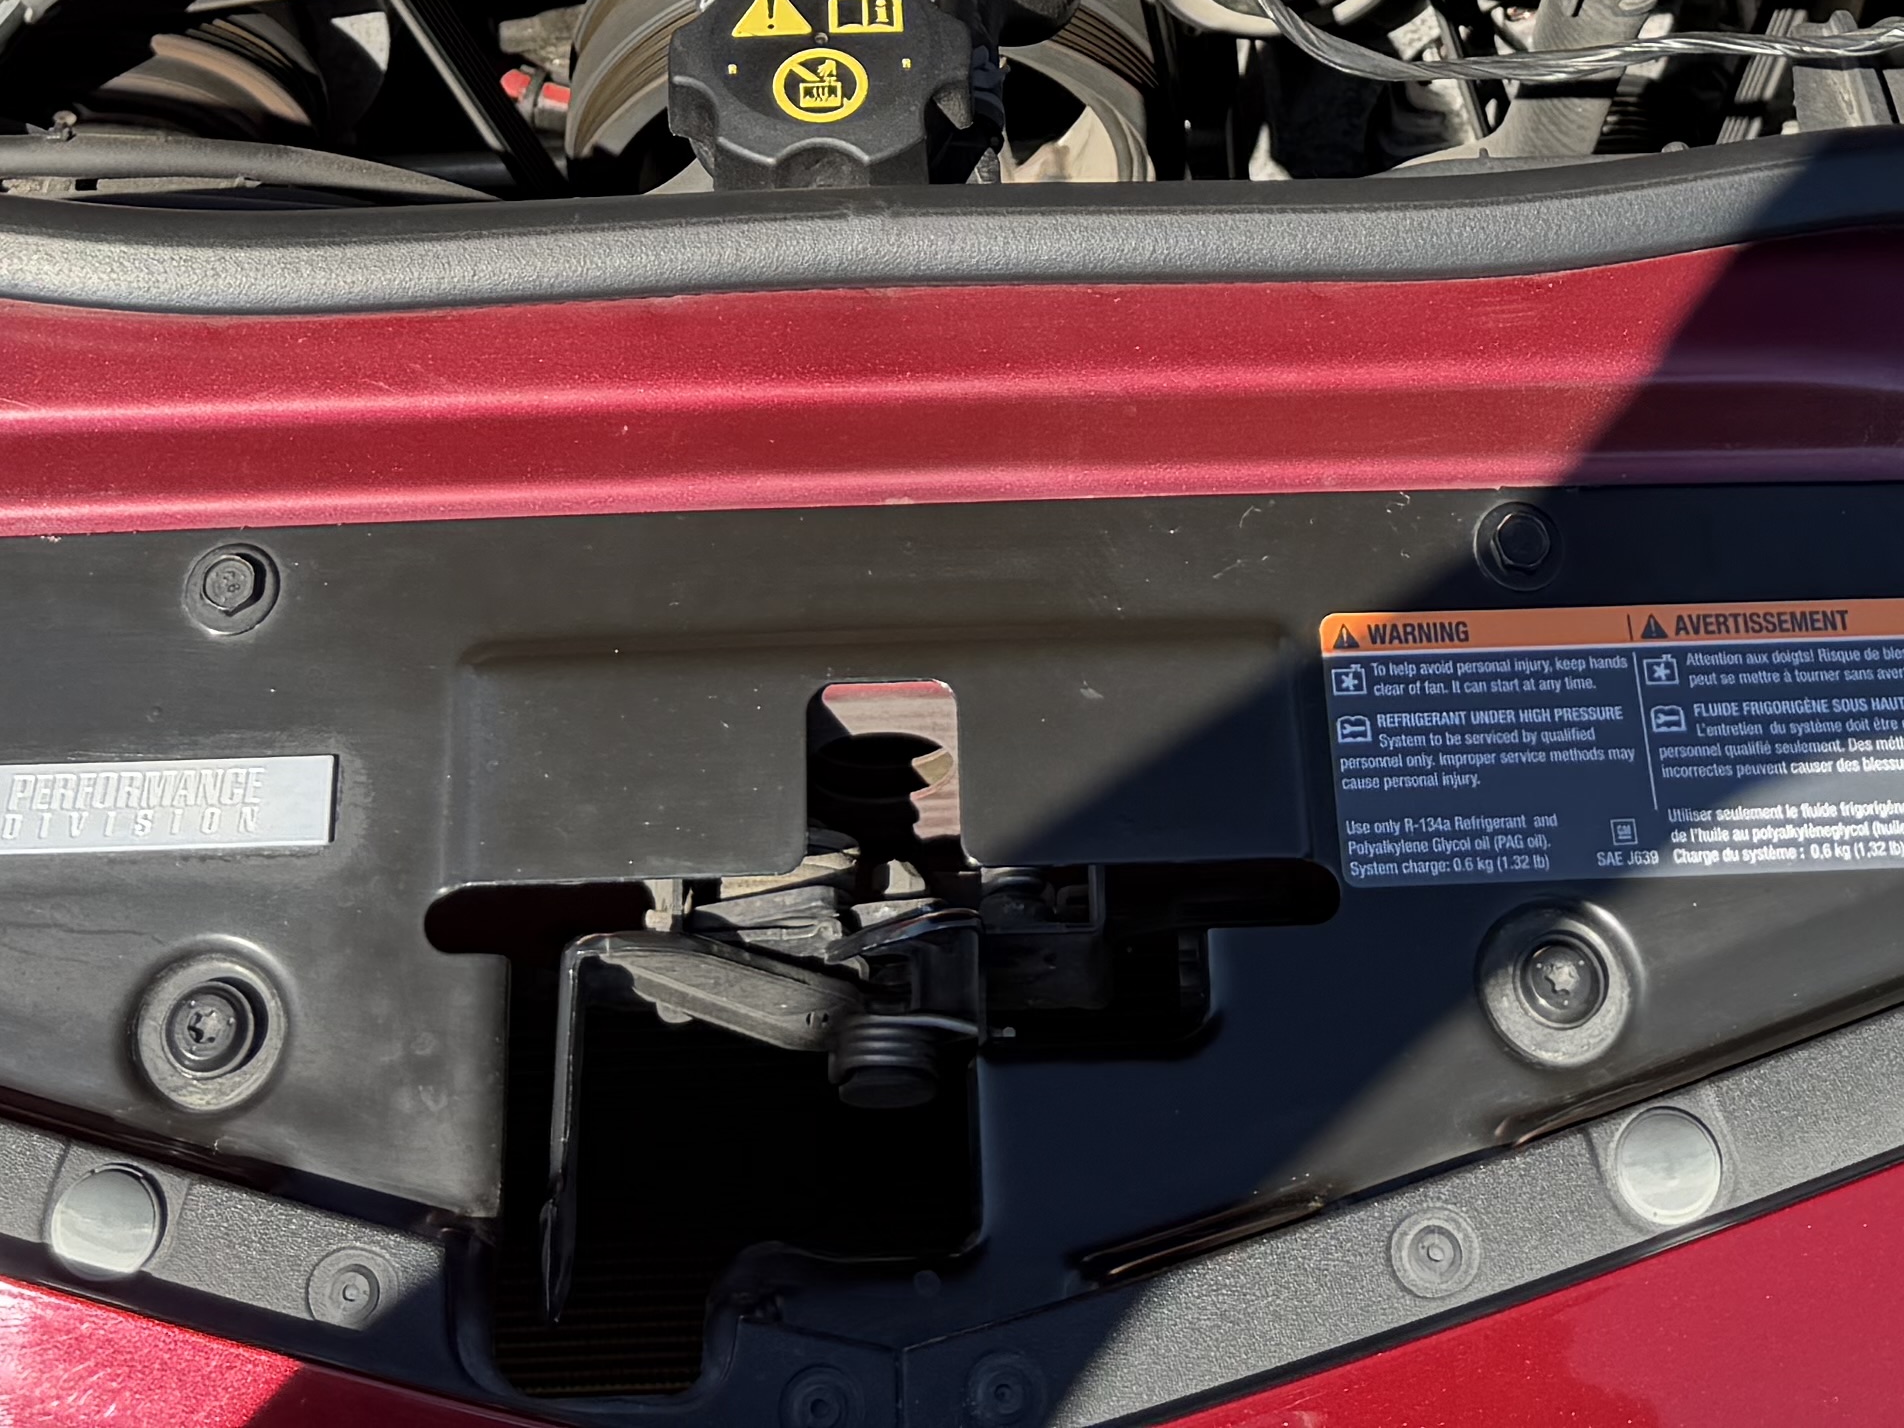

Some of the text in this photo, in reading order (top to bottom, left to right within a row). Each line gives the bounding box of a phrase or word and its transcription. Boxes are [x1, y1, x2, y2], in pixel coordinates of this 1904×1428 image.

[1366, 621, 1470, 645] WARNING
[1674, 609, 1848, 636] AVERTISSEMENT
[1372, 655, 1627, 677] To help avoid personal injury, keep hands
[1686, 651, 1743, 665] Attention
[1746, 653, 1769, 664] aux
[1772, 649, 1814, 665] doigts!
[1818, 648, 1860, 663] Risque
[1864, 647, 1879, 660] de
[1374, 676, 1596, 696] clear of fan. It can start at any time.
[1689, 672, 1717, 688] peut
[1720, 674, 1735, 684] se
[1739, 670, 1780, 684] mettre
[1783, 668, 1792, 682] à
[1794, 669, 1840, 682] tourner
[1843, 669, 1874, 680] sans
[1377, 706, 1623, 727] REFRIGERANT UNDER HIGH PRESSURE
[1693, 702, 1739, 716] FLUIDE
[1742, 697, 1830, 715] FRIGORIGÈNE
[1832, 698, 1867, 712] SOUS
[1696, 721, 1762, 736] L'entretien
[1770, 721, 1786, 734] du
[1789, 718, 1841, 735] système
[1845, 718, 1870, 732] doit
[1873, 717, 1898, 731] être
[1379, 727, 1595, 749] System to be serviced by qualified
[1340, 747, 1634, 771] personnel only. Improper service methods may
[1659, 743, 1721, 760] personnel
[1725, 740, 1771, 758] qualifié
[1775, 739, 1845, 754] seulement.
[1848, 738, 1872, 752] Des
[1661, 763, 1732, 778] incorrectes
[1736, 761, 1788, 778] peuvent
[1790, 761, 1833, 774] causer
[1837, 758, 1859, 772] des
[7, 768, 266, 812] PERFORMANCE
[1342, 771, 1480, 790] cause personal injury.
[1668, 808, 1712, 823] Utiliser
[1716, 804, 1784, 821] seulement
[1785, 804, 1797, 818] le
[1801, 802, 1837, 819] fluide
[1346, 820, 1370, 835] Use
[1374, 819, 1400, 835] only
[1455, 815, 1526, 832] Refrigerant
[1533, 813, 1557, 827] and
[1671, 829, 1687, 843] de
[1690, 826, 1729, 843] l'huile
[1732, 829, 1749, 840] au
[1348, 839, 1428, 857] Polyalkylene
[1432, 837, 1471, 854] Glycol
[1475, 836, 1490, 849] oil
[1494, 834, 1524, 852] (PAG
[1673, 848, 1719, 864] Charge
[1723, 847, 1739, 861] du
[1742, 844, 1795, 863] système
[1834, 842, 1850, 860] kg
[1889, 840, 1904, 857] lb)
[1350, 861, 1398, 878] System
[1402, 859, 1450, 875] charge:
[1476, 857, 1493, 872] kg
[1497, 855, 1530, 872] (1.32
[1533, 854, 1549, 870] lb)
[1597, 850, 1658, 865] SAE J639
